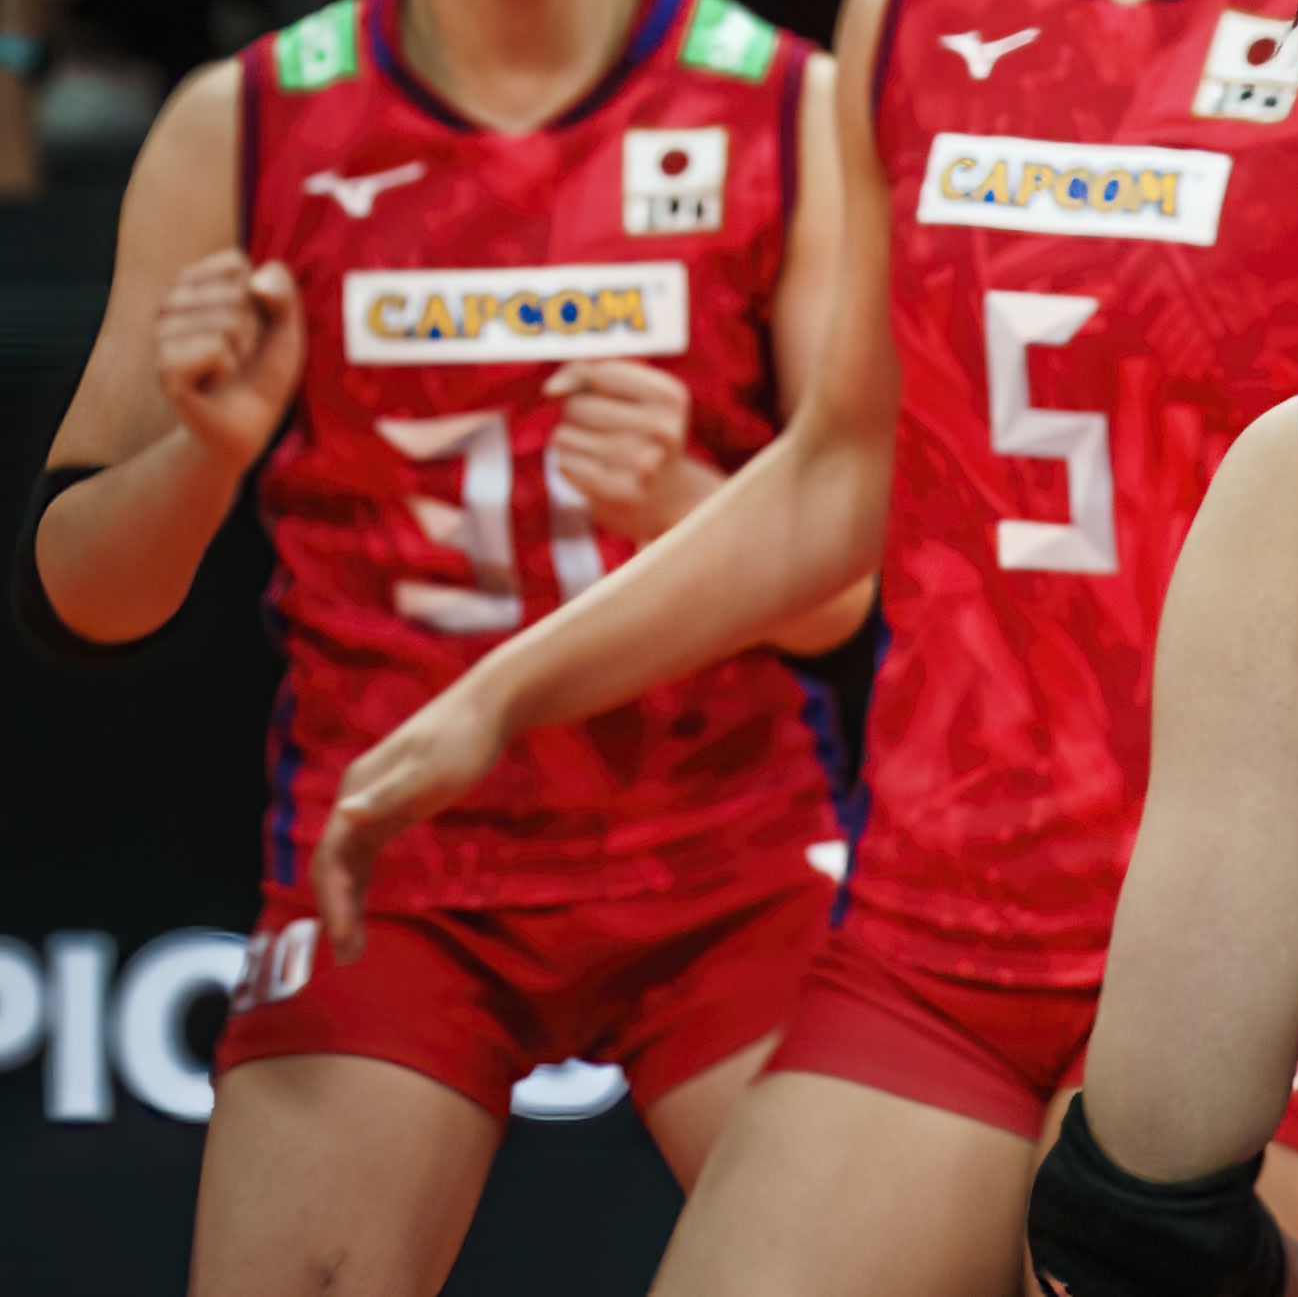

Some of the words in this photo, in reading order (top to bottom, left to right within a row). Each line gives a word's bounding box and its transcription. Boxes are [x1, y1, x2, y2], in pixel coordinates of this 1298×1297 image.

[938, 157, 1180, 217] CAPCOM
[367, 288, 648, 342] CAPCOM
[984, 290, 1119, 574] 5
